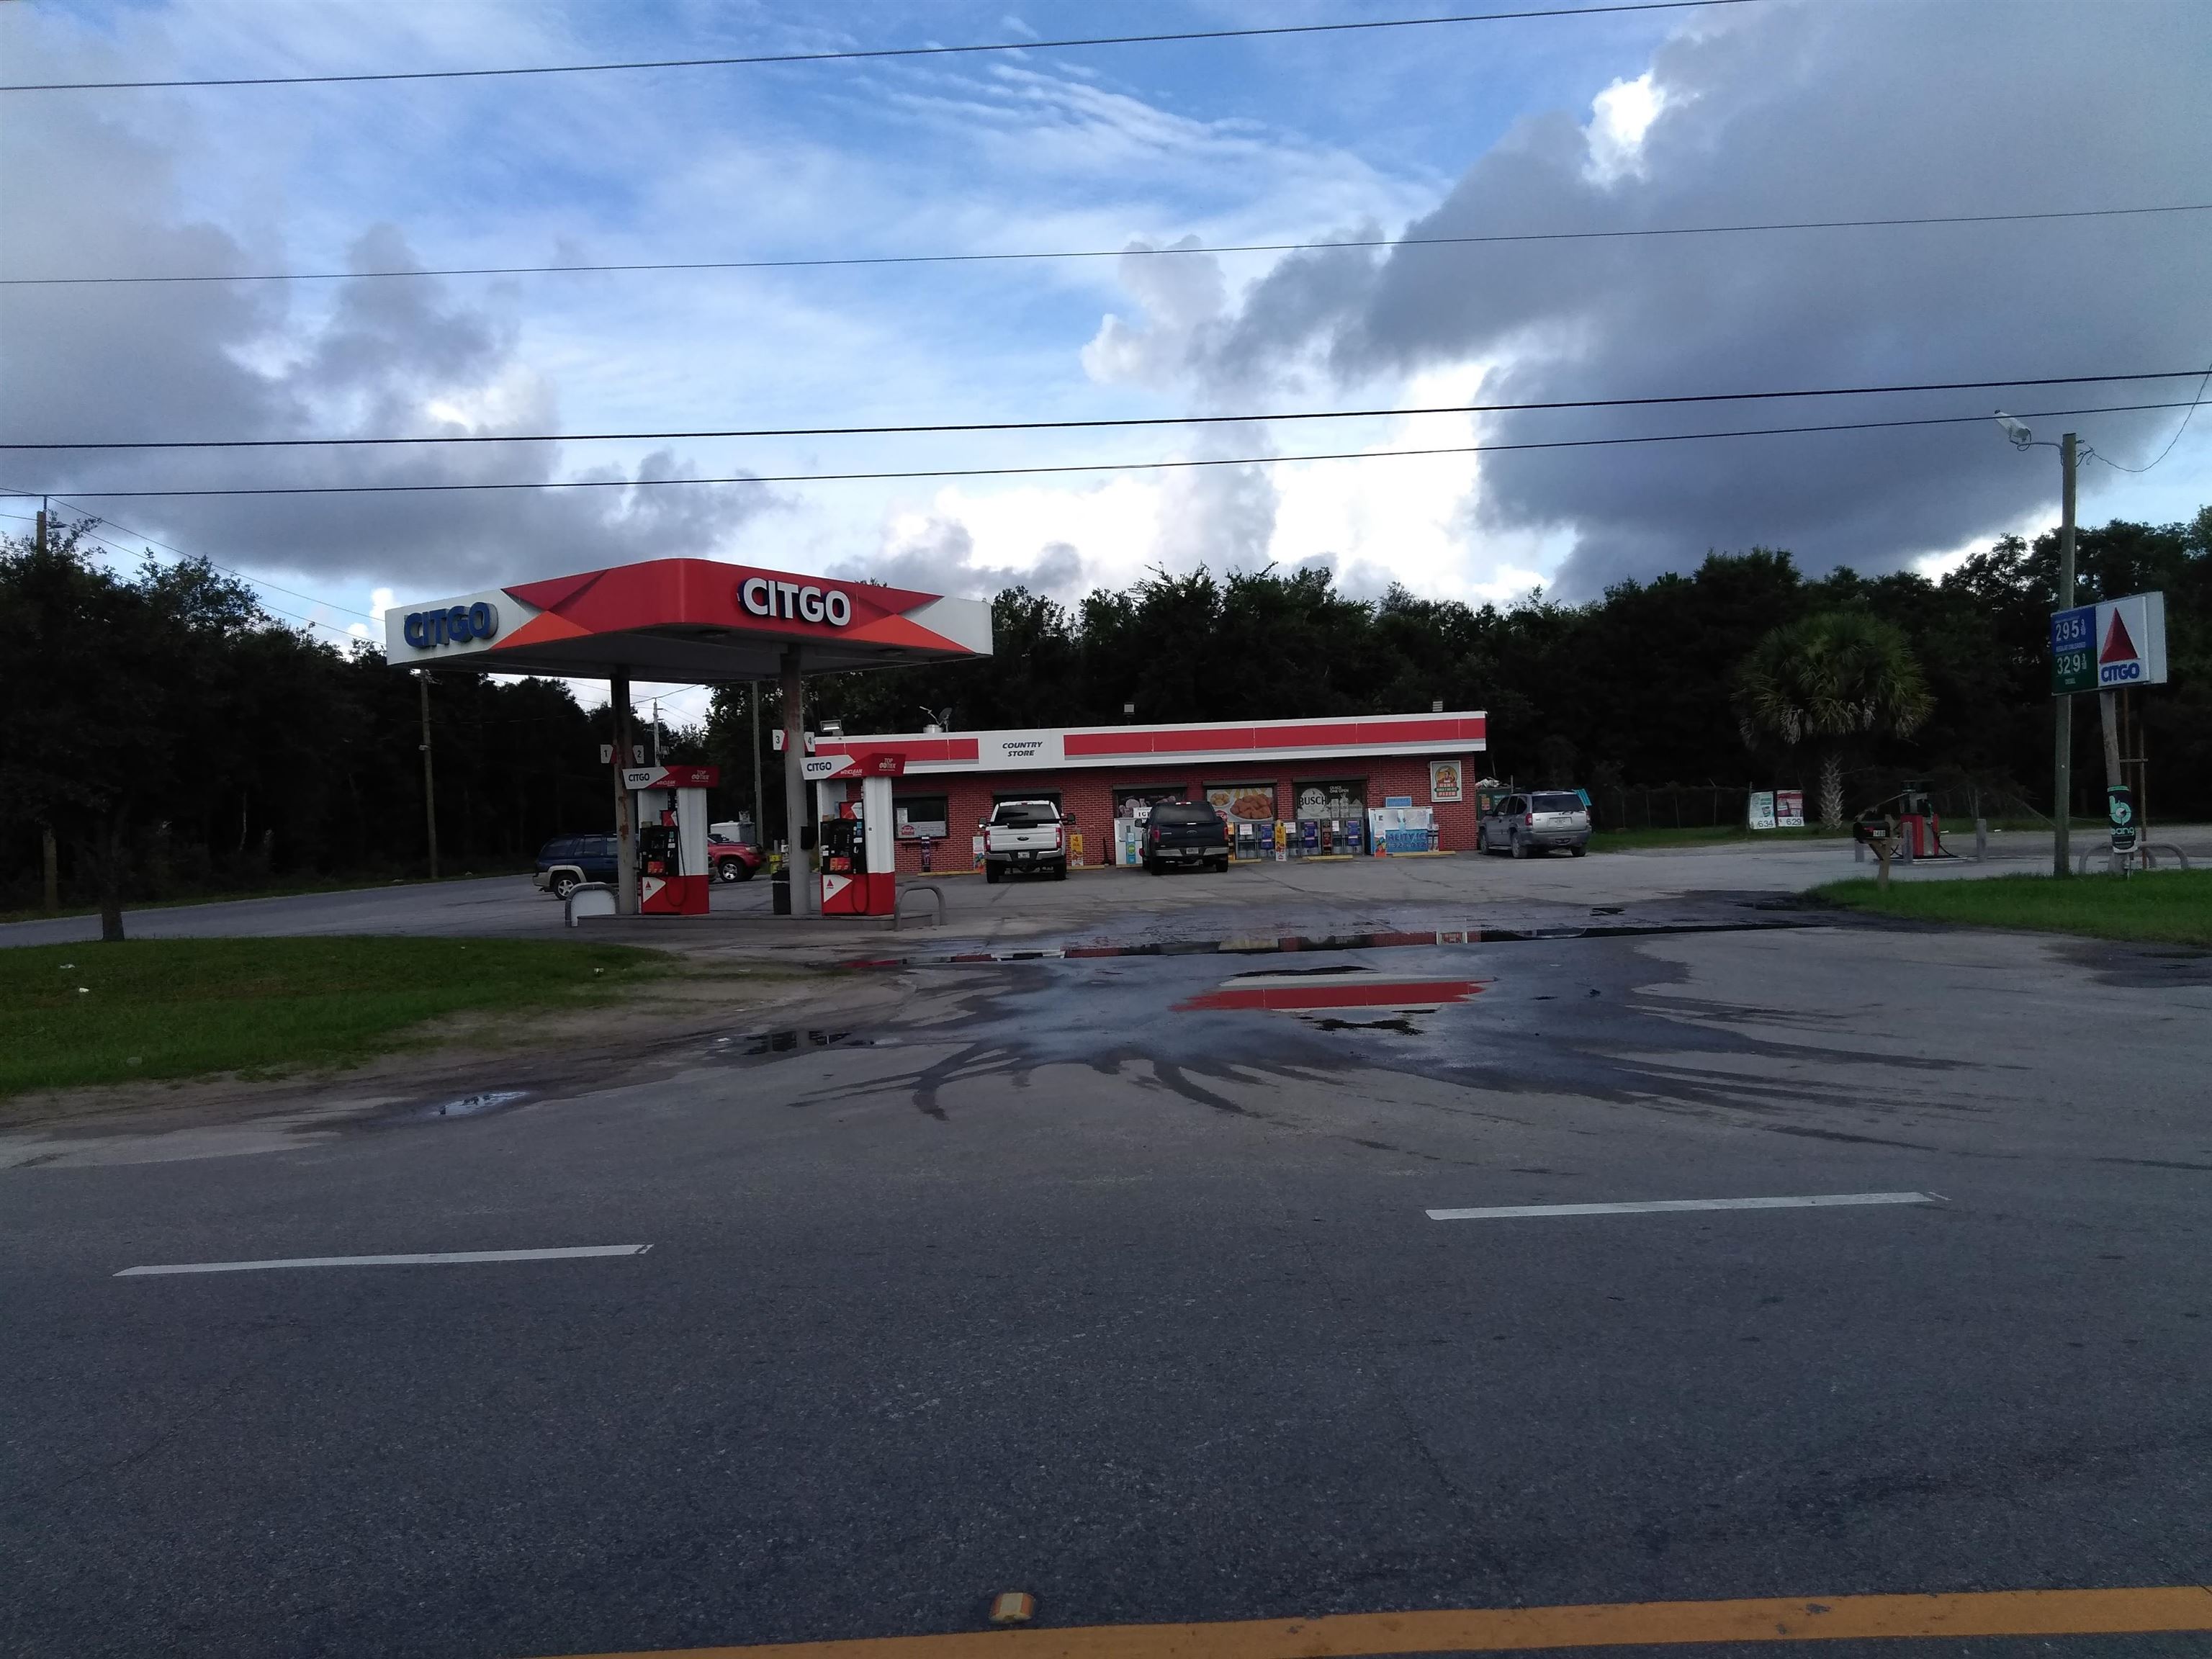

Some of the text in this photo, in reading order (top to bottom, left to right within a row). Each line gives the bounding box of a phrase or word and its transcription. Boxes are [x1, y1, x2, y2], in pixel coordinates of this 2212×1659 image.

[743, 577, 851, 626] CITGO
[404, 602, 497, 649] CITGO
[2056, 620, 2079, 642] 295
[2057, 654, 2080, 675] 329
[2100, 662, 2140, 682] CITGO
[806, 762, 832, 771] CITGO
[628, 773, 650, 782] CITGO
[1298, 796, 1326, 805] BUSCH
